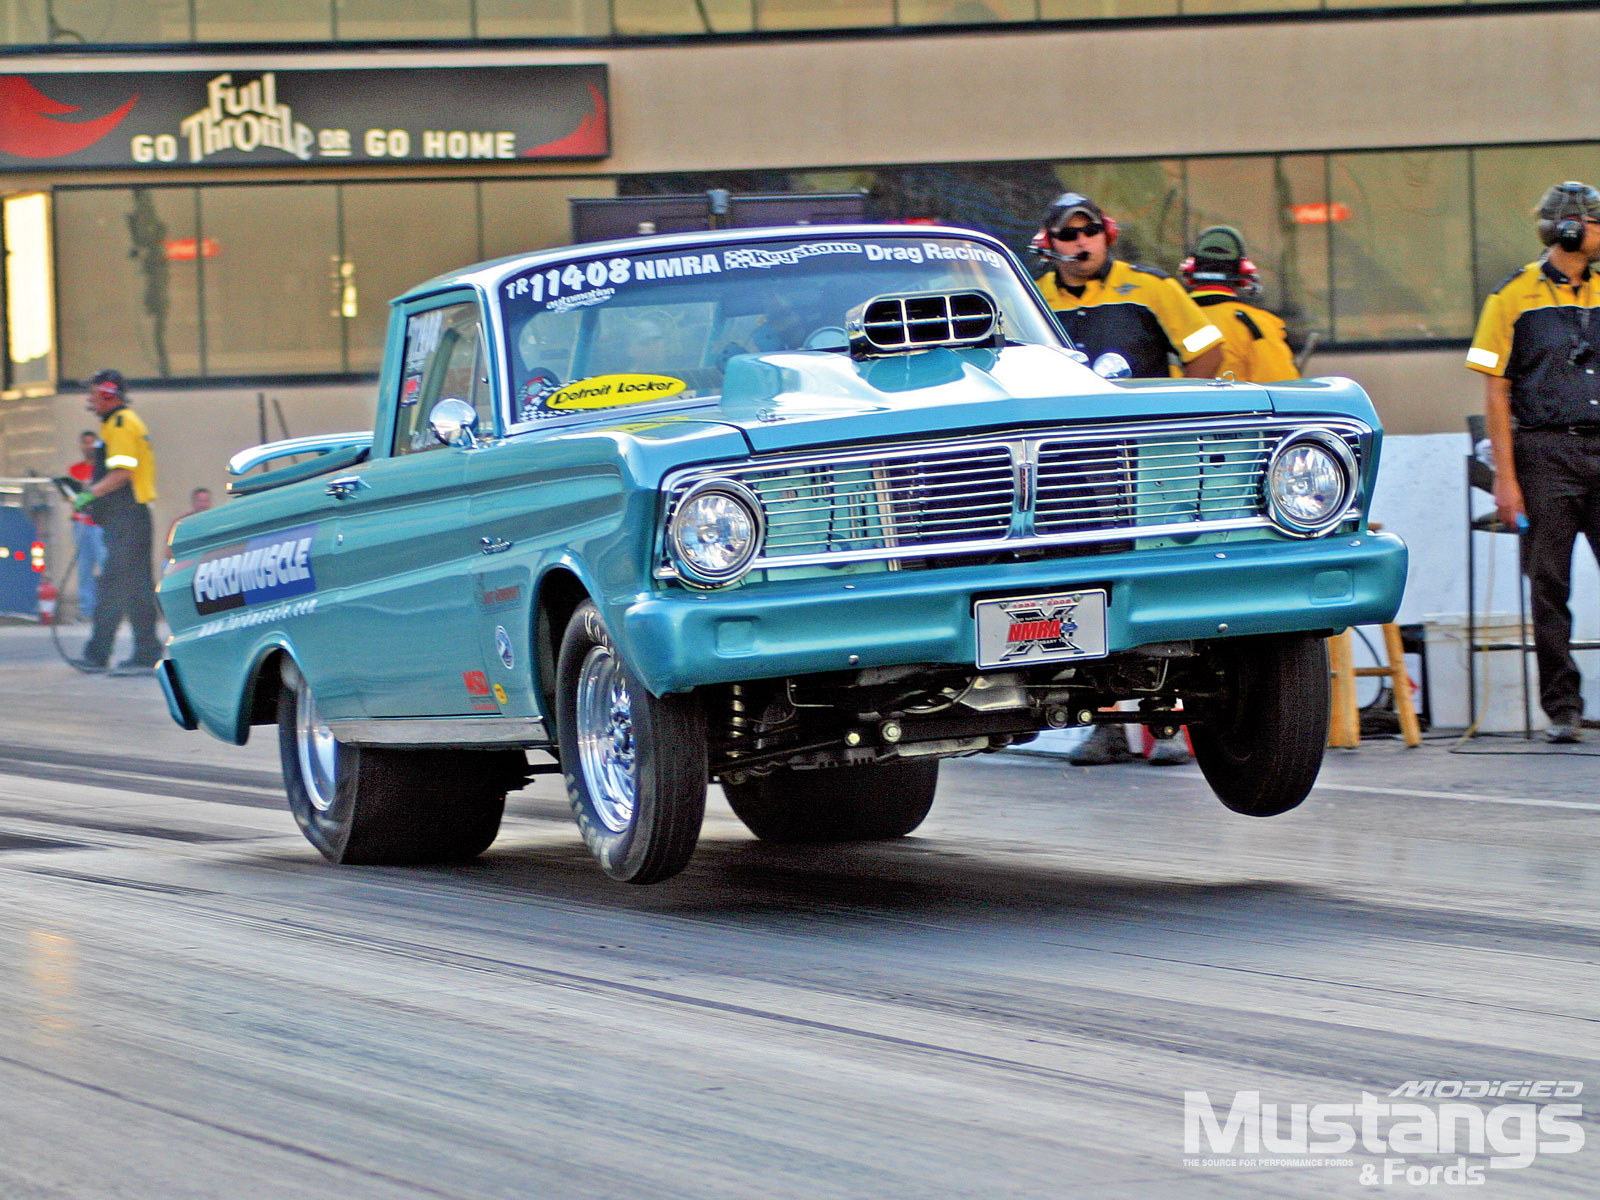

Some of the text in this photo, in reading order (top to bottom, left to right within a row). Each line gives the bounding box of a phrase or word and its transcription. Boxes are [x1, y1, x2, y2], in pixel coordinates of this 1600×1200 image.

[207, 72, 281, 121] Full
[131, 103, 516, 163] GO Throttle OR GO HOME
[505, 277, 530, 300] TR
[529, 257, 632, 302] 11408
[635, 253, 722, 281] NMRA
[864, 244, 924, 264] Drag
[922, 243, 1001, 269] Racing
[553, 381, 675, 406] Detroit Locker
[193, 537, 313, 603] FORDMUSCLE
[1007, 618, 1061, 642] NMRA
